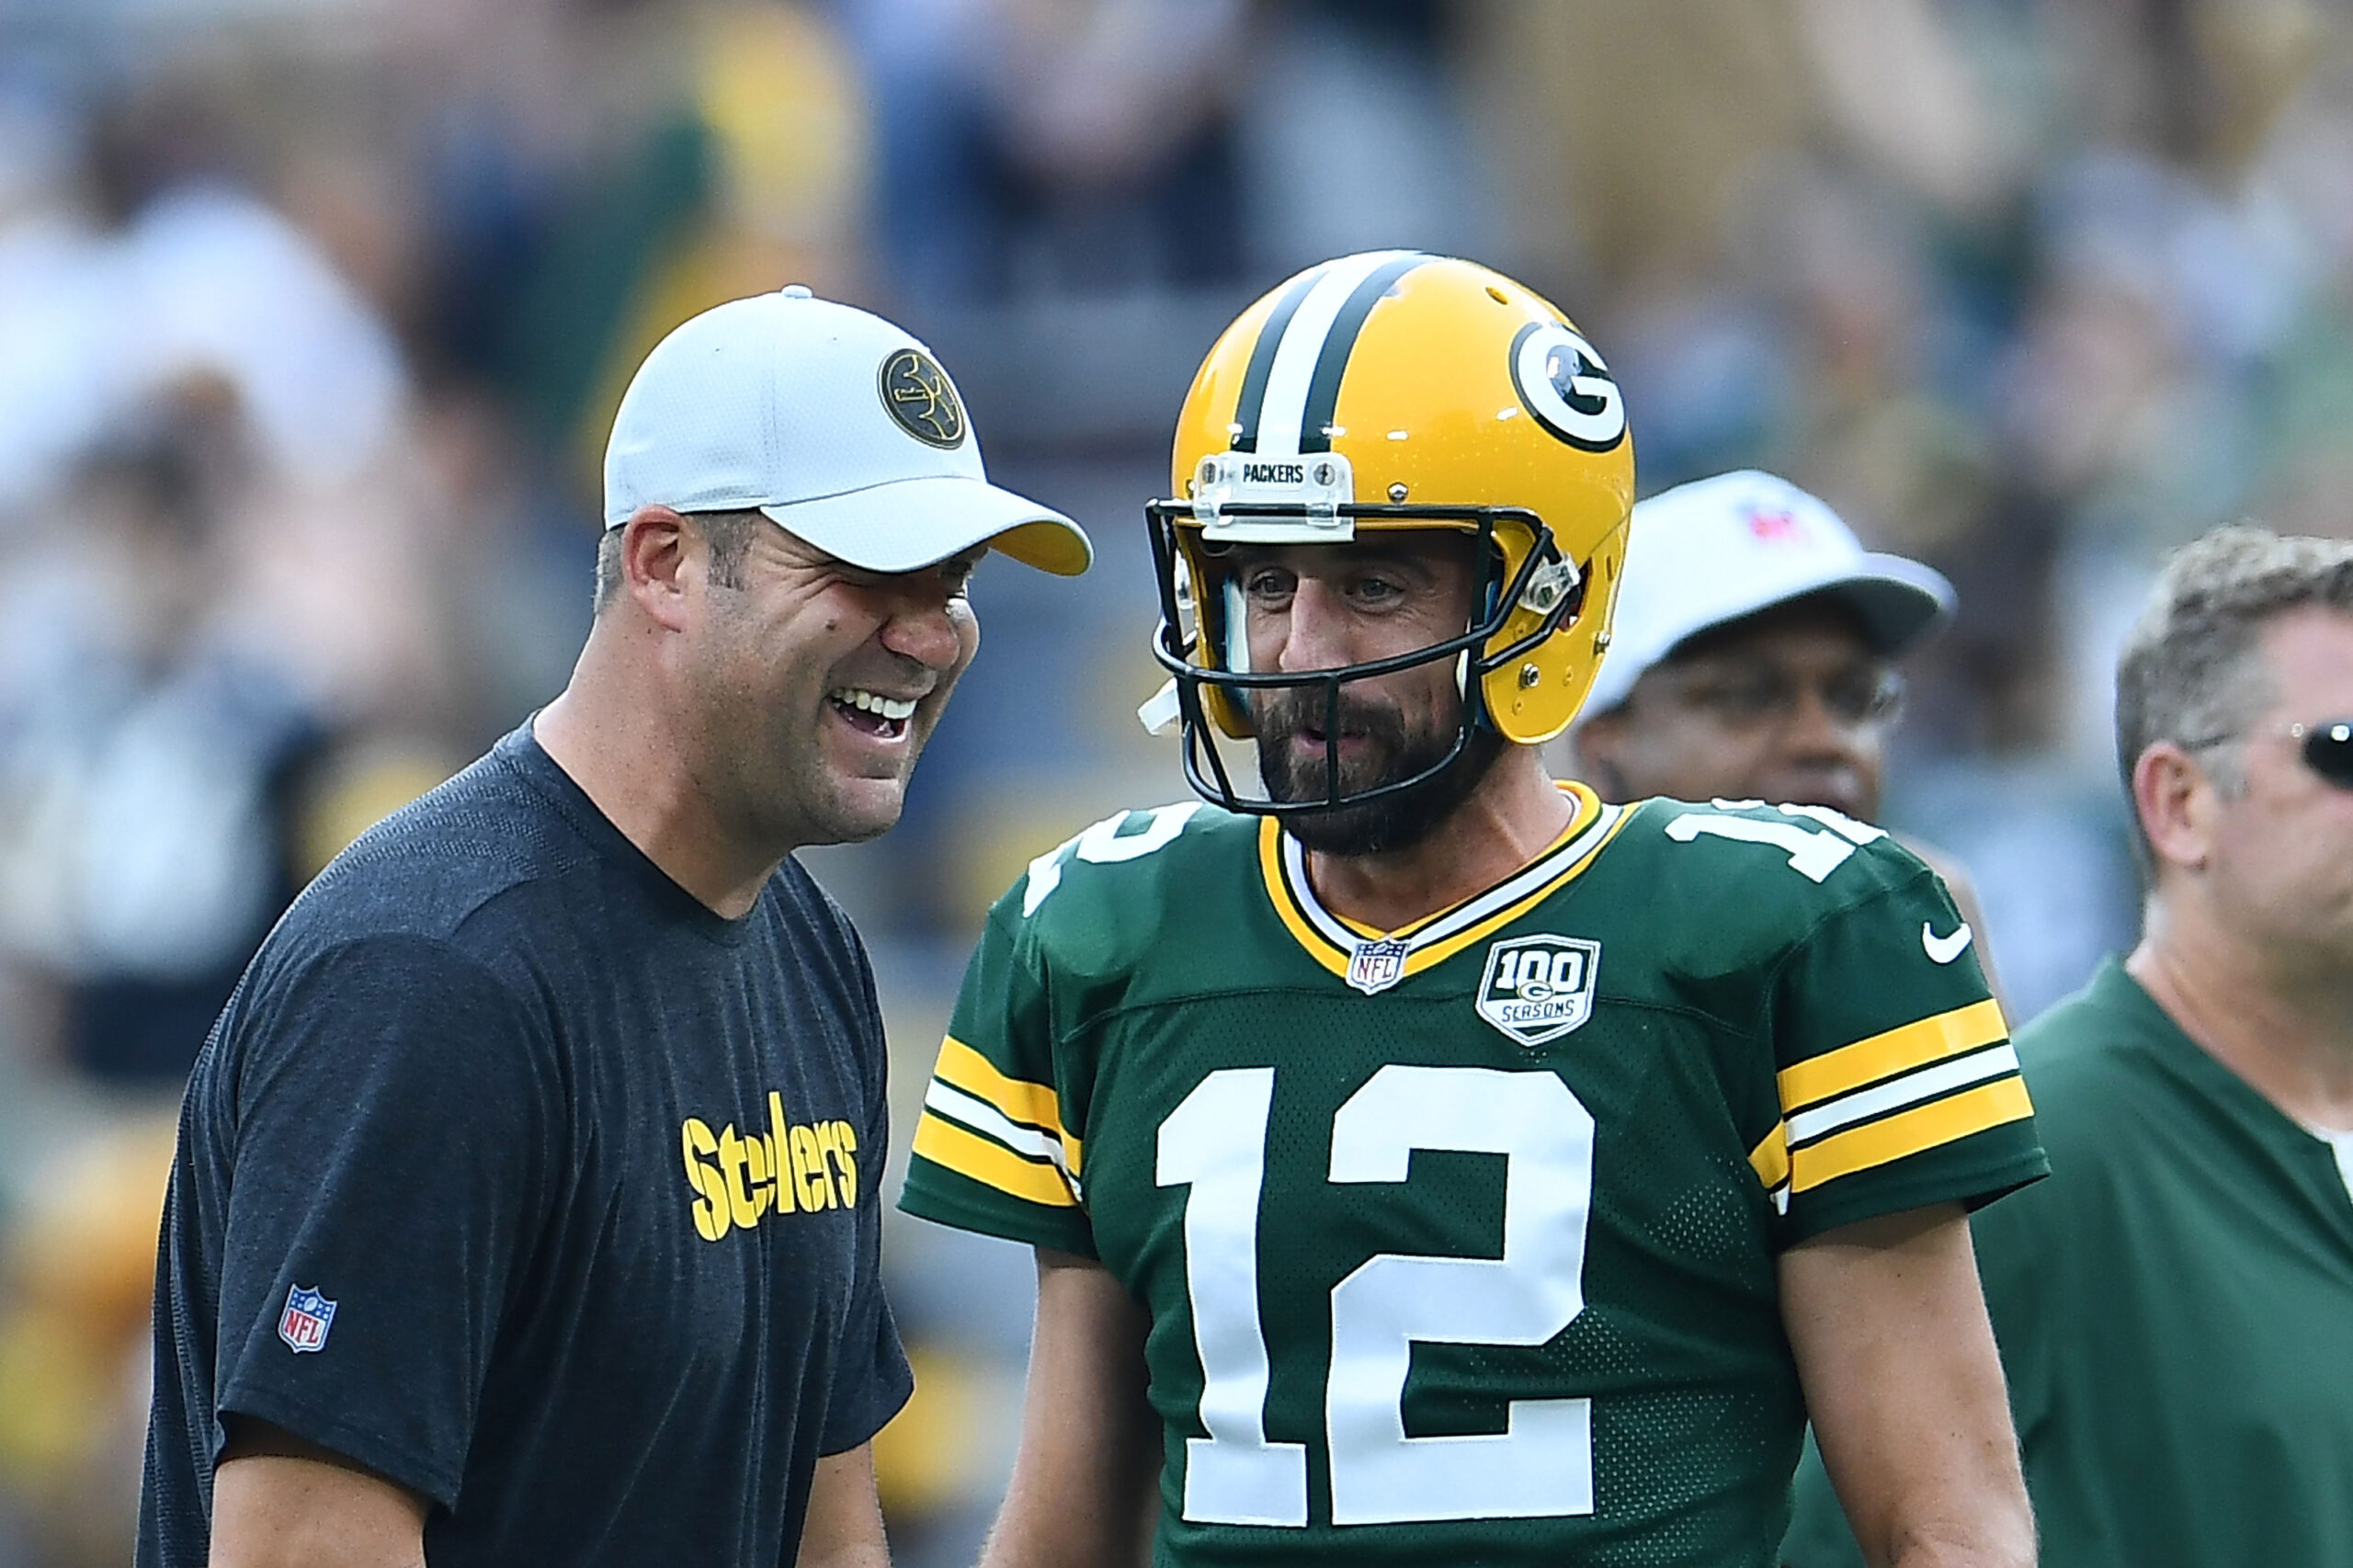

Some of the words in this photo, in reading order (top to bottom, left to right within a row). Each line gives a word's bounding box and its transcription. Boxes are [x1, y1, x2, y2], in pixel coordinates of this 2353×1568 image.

[1243, 463, 1303, 483] PACKERS
[1358, 958, 1392, 983] NFL
[1495, 950, 1583, 993] 100
[1502, 999, 1574, 1022] SEASONS
[1155, 1064, 1596, 1528] 12
[284, 1309, 320, 1344] NFL
